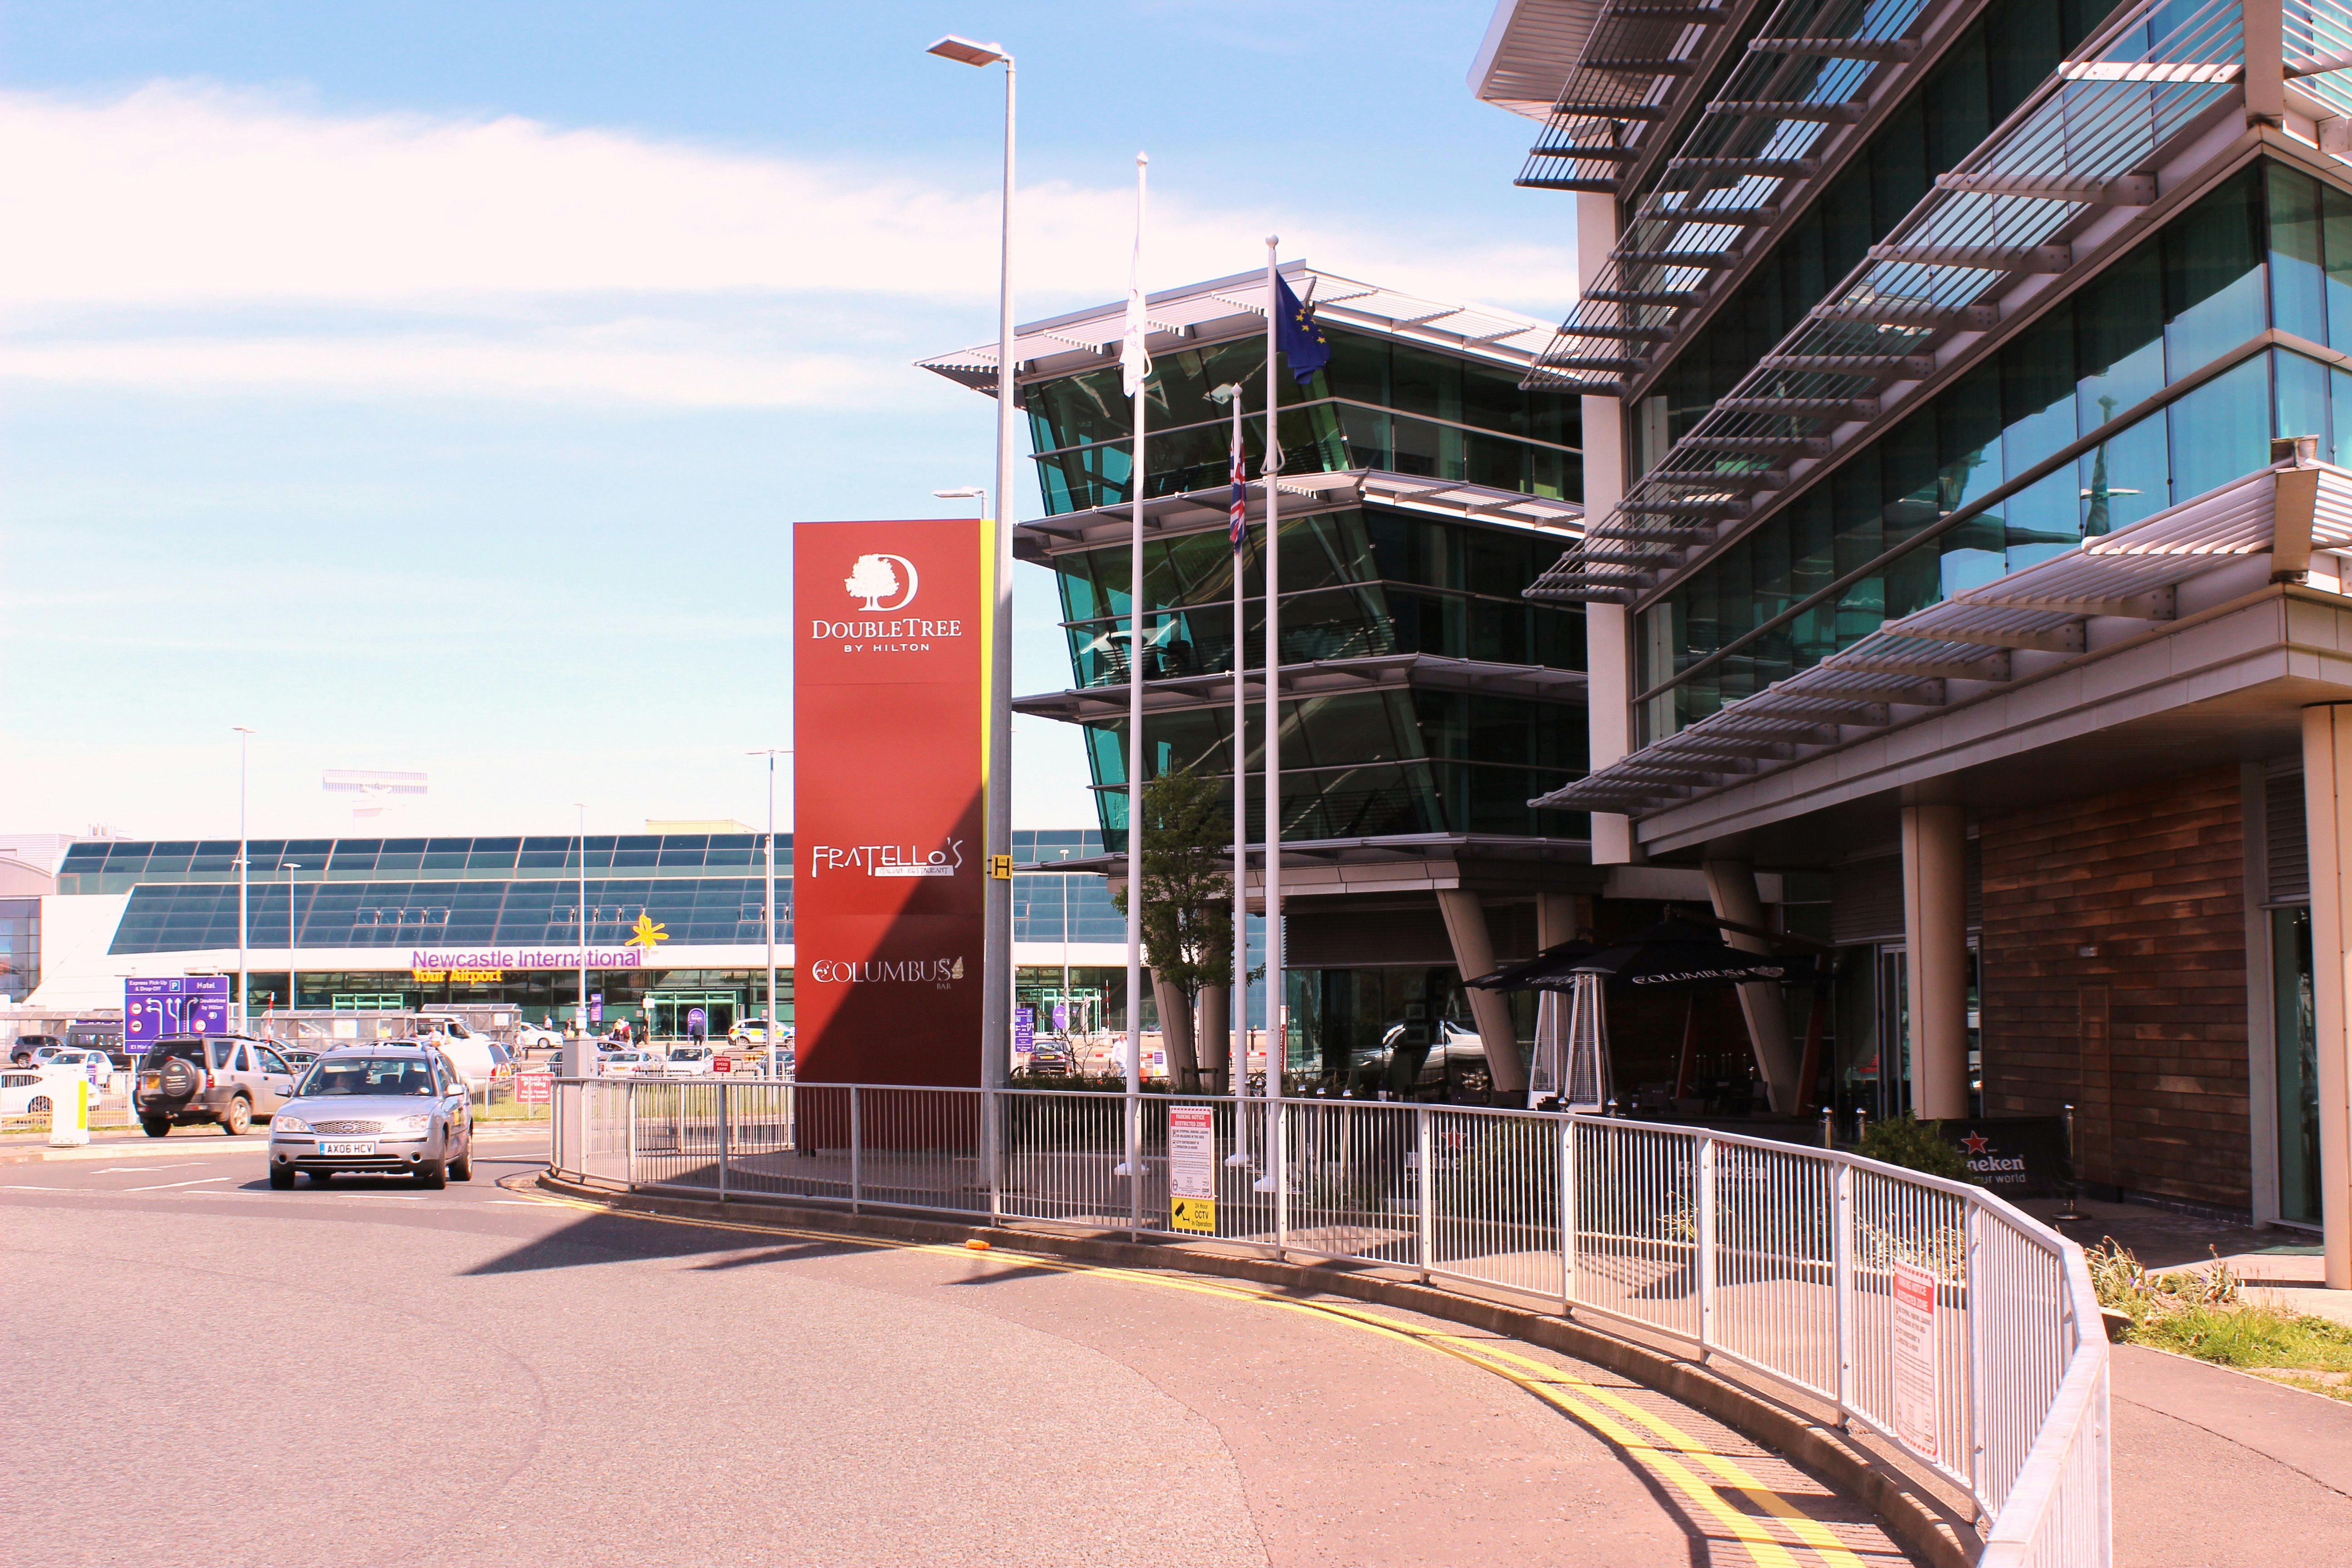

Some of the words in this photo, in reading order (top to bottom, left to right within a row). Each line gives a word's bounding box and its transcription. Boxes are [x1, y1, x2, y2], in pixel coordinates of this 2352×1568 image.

[873, 643, 929, 652] HILTON
[995, 857, 1010, 877] H
[413, 951, 513, 967] Newcastle
[519, 949, 641, 967] International
[412, 968, 446, 982] Your
[450, 969, 502, 984] Airport
[812, 958, 951, 983] COLUMBUS
[1632, 968, 1735, 984] COLUMBUS
[328, 1144, 351, 1153] AX06
[354, 1144, 372, 1152] HCV
[1967, 1156, 2025, 1171] neken
[1995, 1173, 2025, 1183] world
[1195, 1210, 1209, 1219] CCTV
